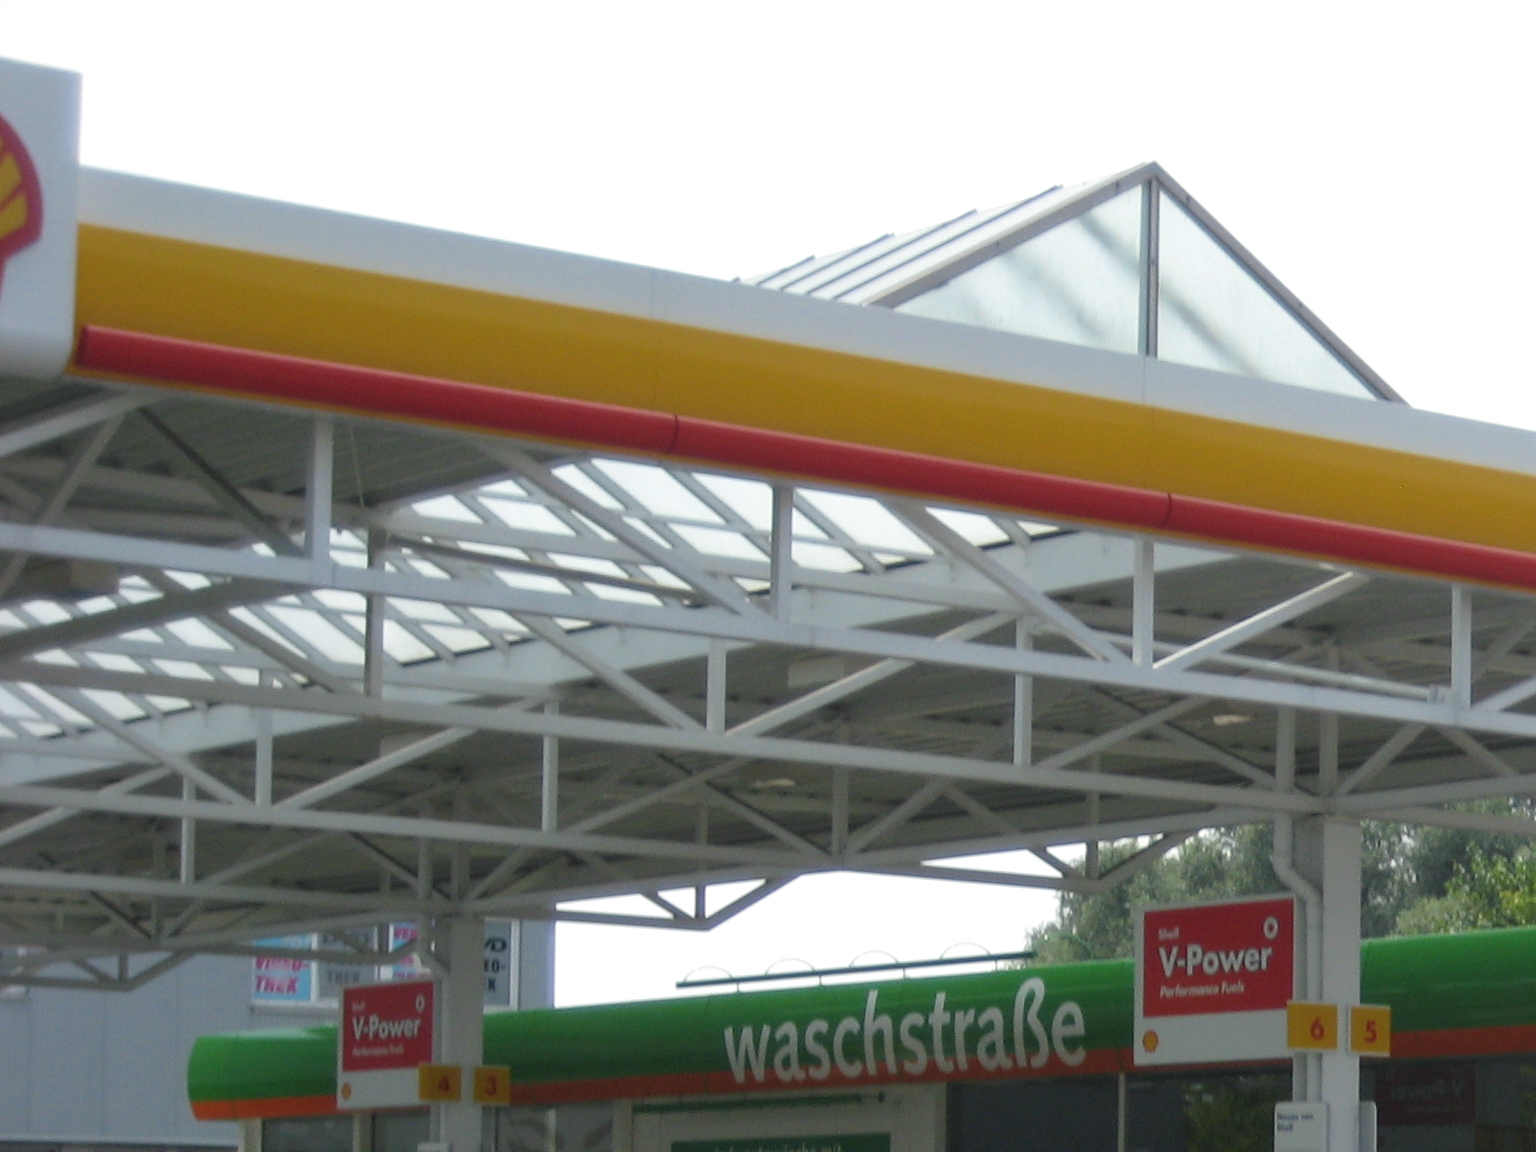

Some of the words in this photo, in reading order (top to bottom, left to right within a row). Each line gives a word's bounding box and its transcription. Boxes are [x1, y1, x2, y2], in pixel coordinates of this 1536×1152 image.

[1158, 943, 1273, 978] V-Power
[352, 1013, 421, 1041] V-Power
[724, 977, 1087, 1084] waschstraße
[1309, 1016, 1325, 1040] 6
[1364, 1019, 1378, 1043] 5
[438, 1076, 450, 1093] 4
[485, 1076, 498, 1096] 3
